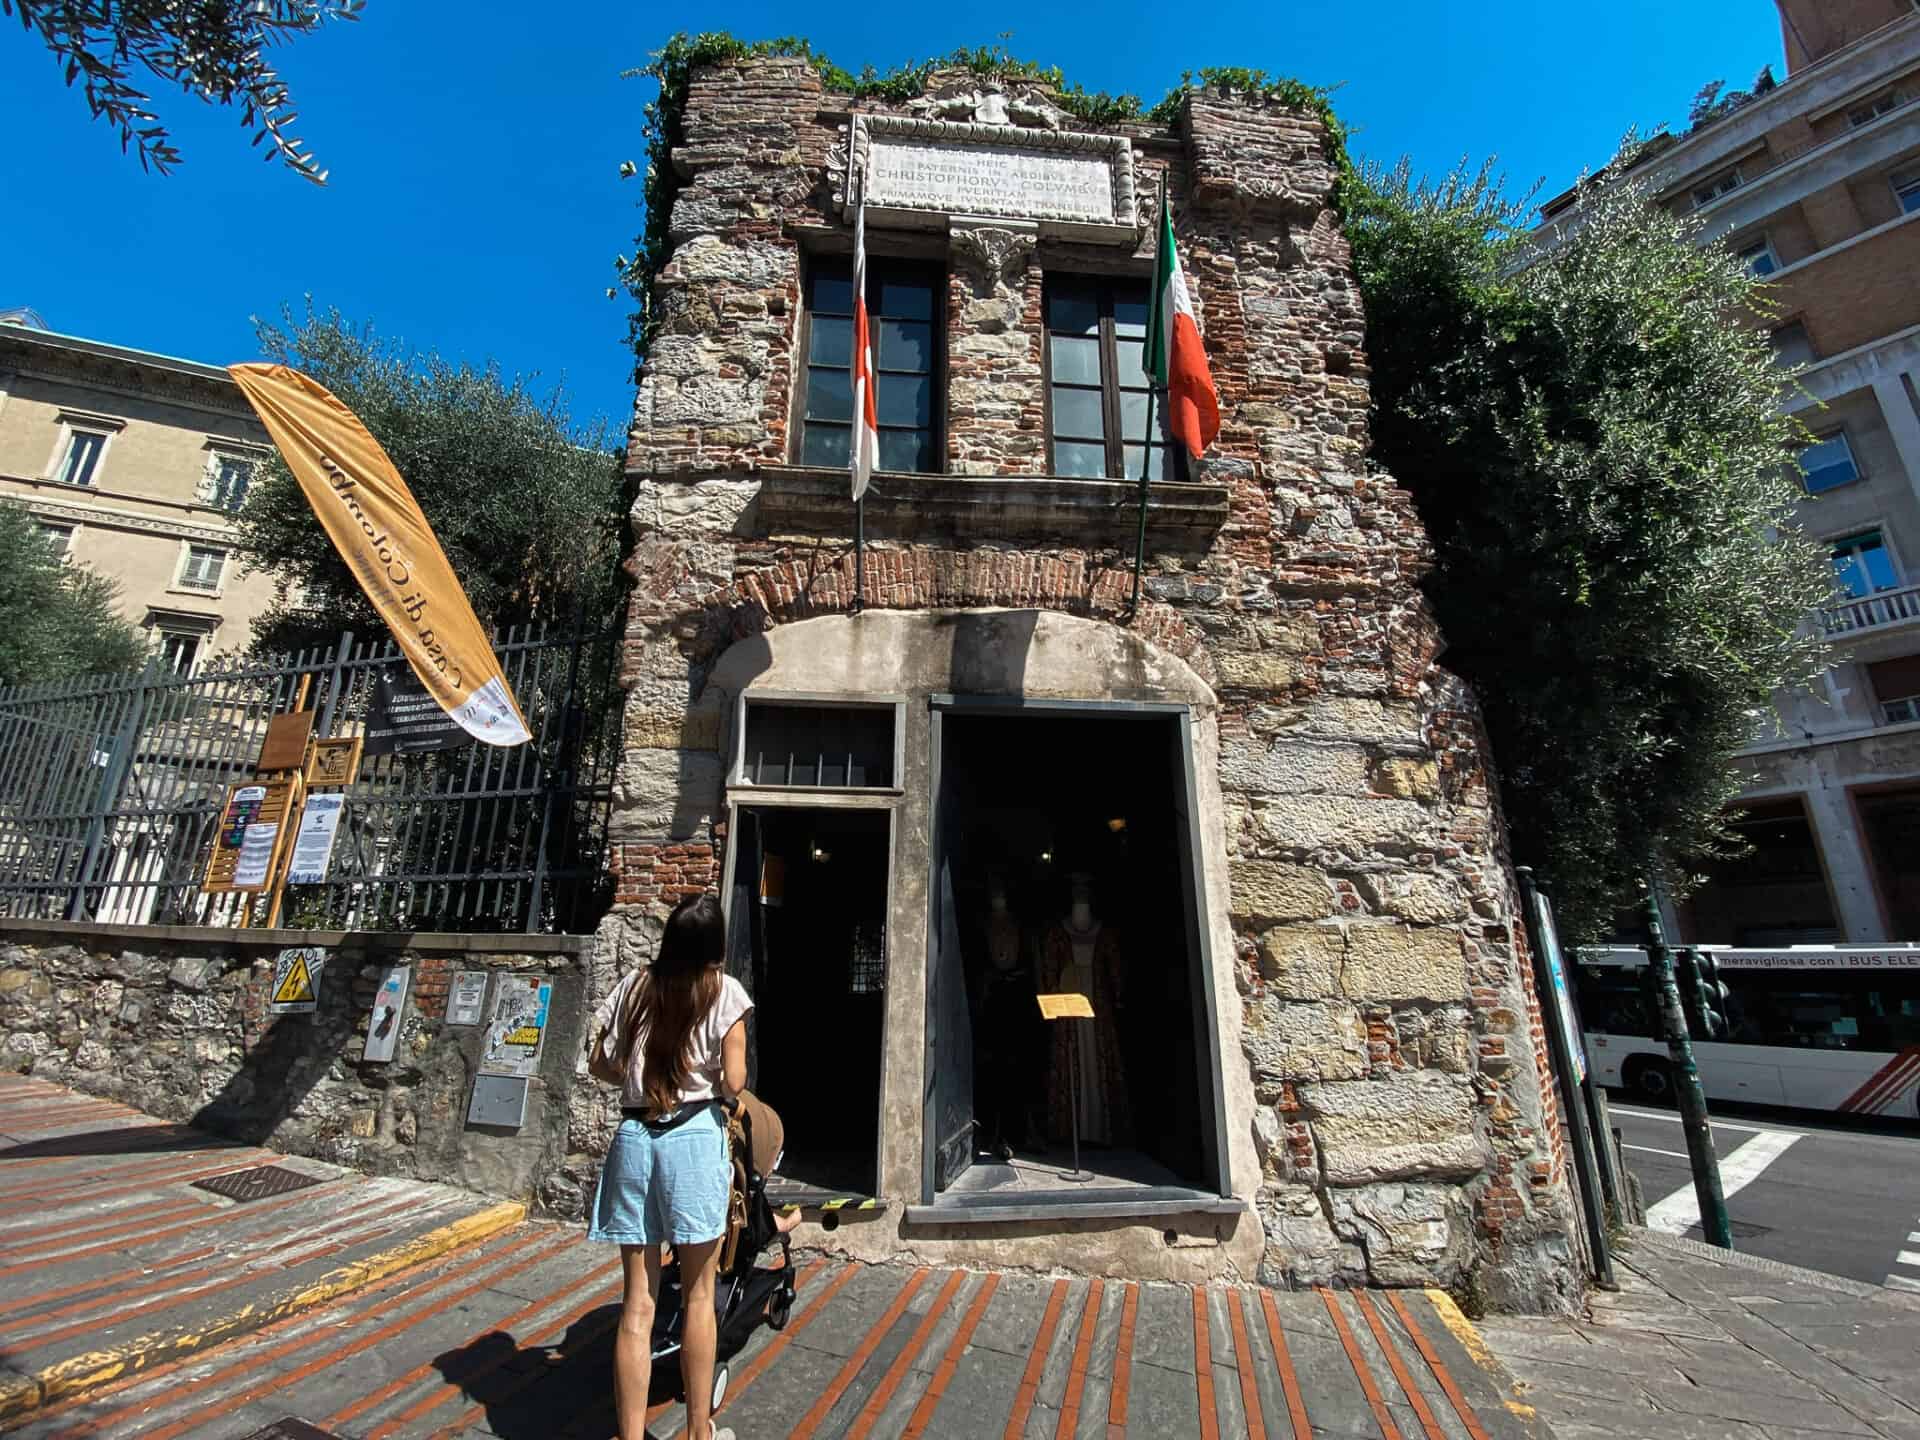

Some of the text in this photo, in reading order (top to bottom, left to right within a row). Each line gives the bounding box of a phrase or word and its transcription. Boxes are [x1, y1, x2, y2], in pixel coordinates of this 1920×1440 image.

[918, 163, 979, 176] PATERNIS
[876, 169, 1107, 196] CHRISTOPHORVS COLVMBVS
[1720, 956, 1804, 967] meravigliosa
[1810, 957, 1835, 966] con
[1850, 954, 1882, 966] BUS
[1887, 955, 1920, 966] ELE
